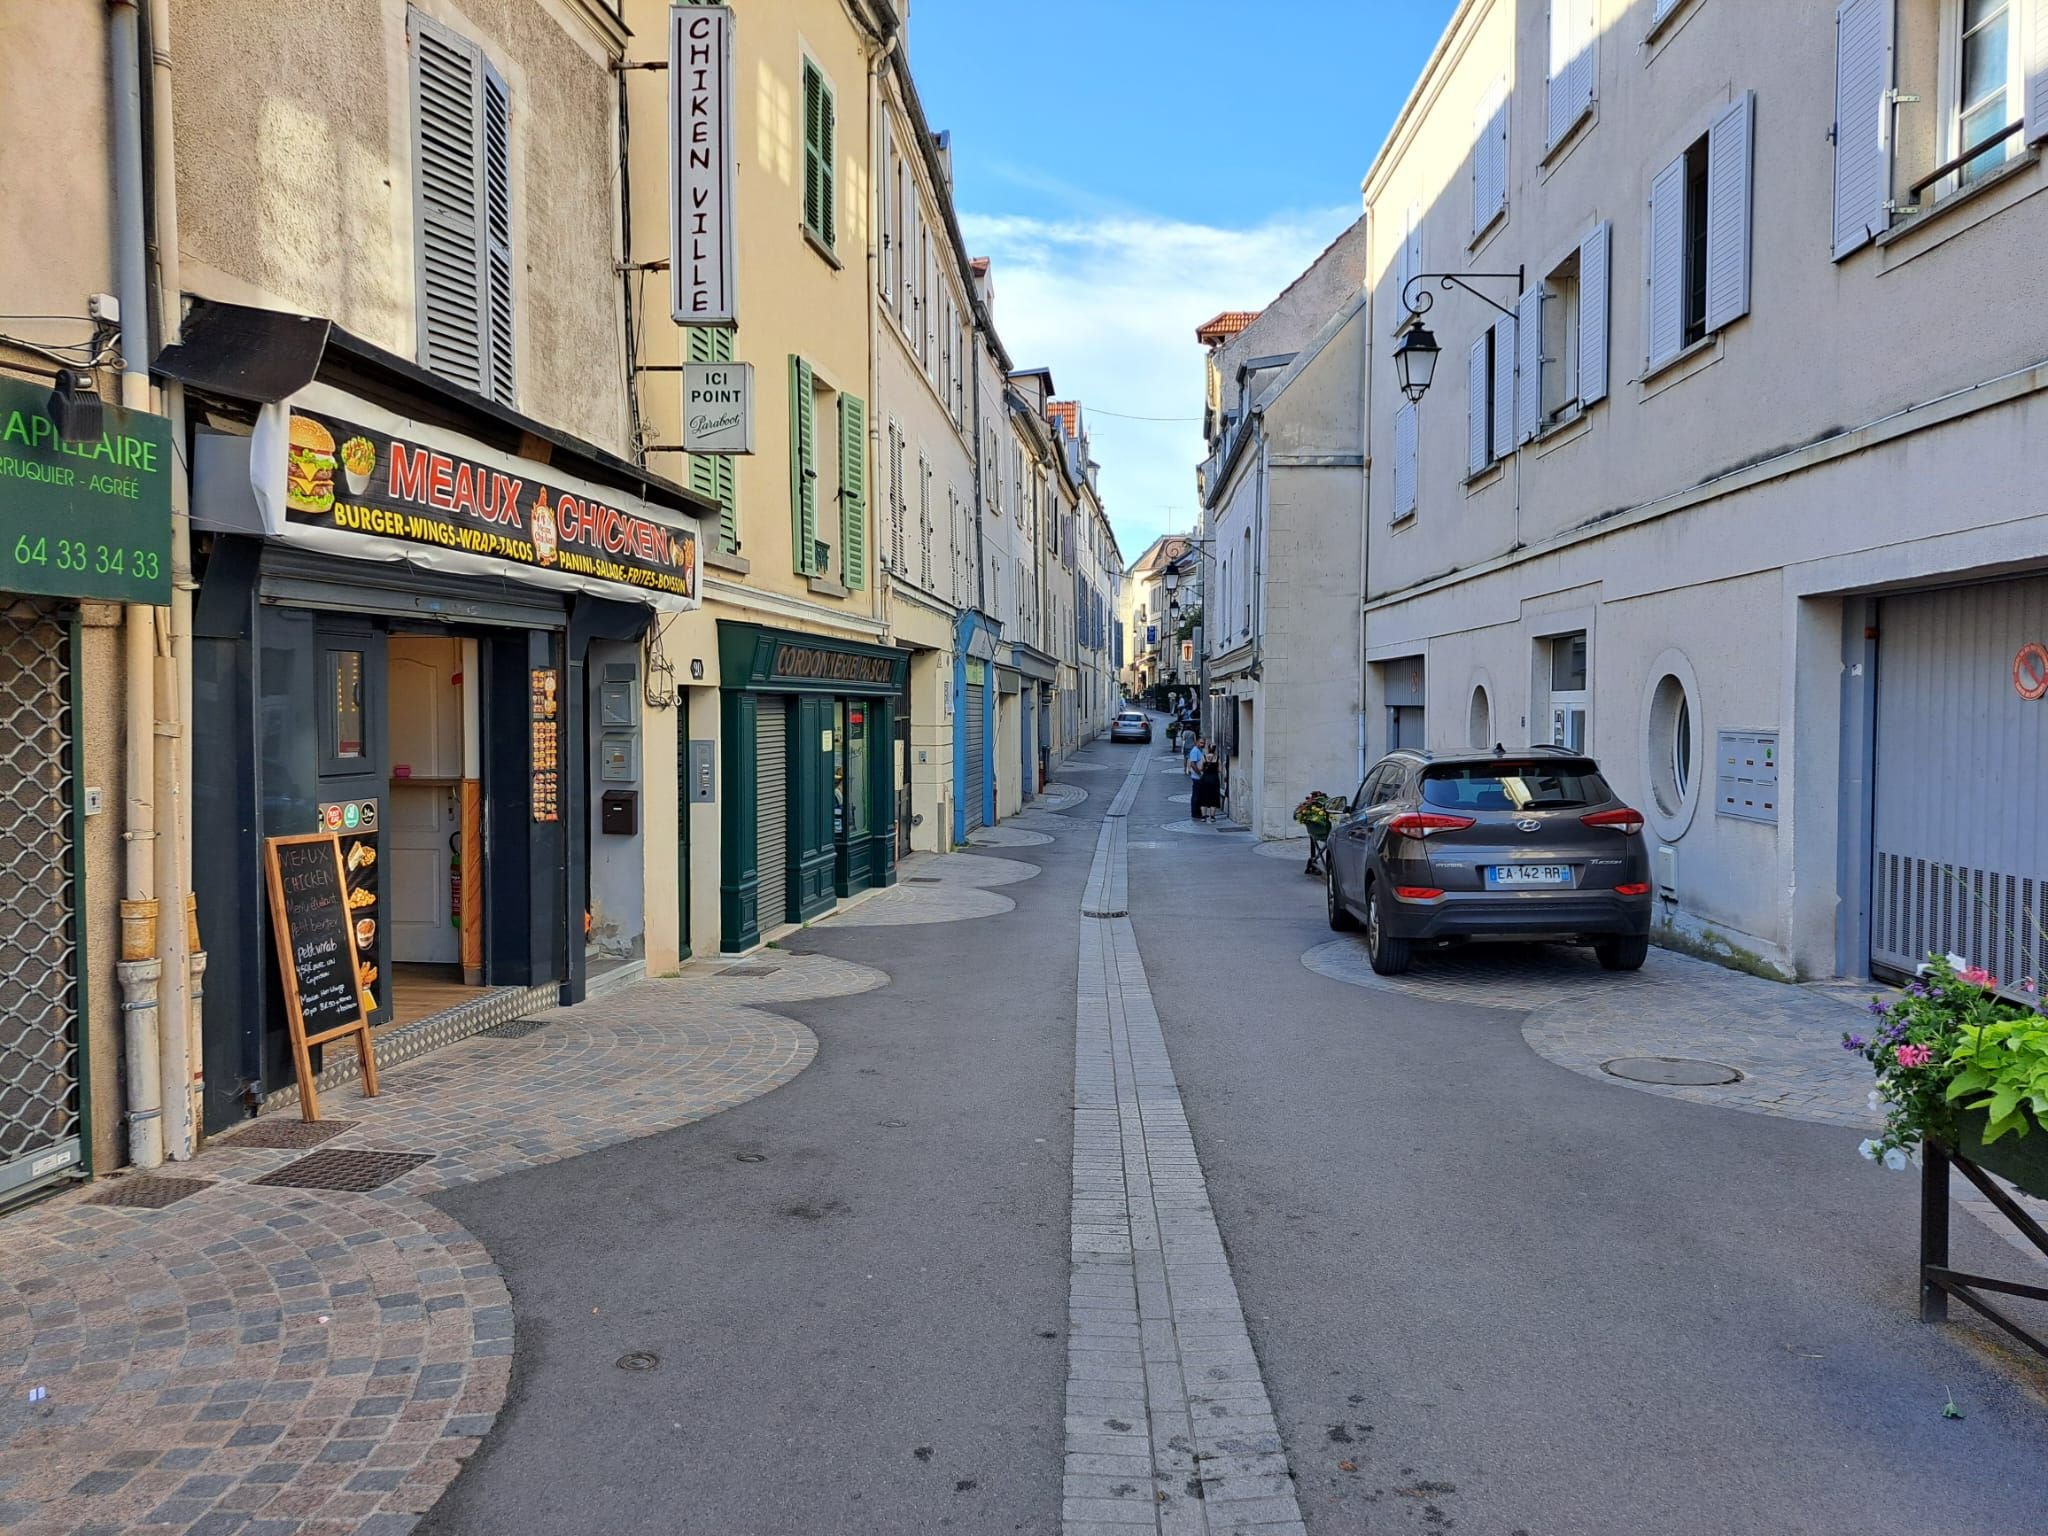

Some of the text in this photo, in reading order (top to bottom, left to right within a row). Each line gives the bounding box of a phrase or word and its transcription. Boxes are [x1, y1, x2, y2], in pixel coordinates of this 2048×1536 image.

[689, 17, 710, 311] CHIKEN VILLE
[705, 372, 727, 385] ICI
[691, 390, 741, 403] POINT
[689, 413, 741, 435] Paraboot
[0, 411, 157, 472] APIAIRE
[89, 474, 140, 499] AGRÉÉ
[388, 441, 522, 529] MEAUX
[557, 494, 670, 565] CHICKEN
[15, 534, 158, 580] 64 33 34 33
[284, 866, 334, 893] CHICKEN
